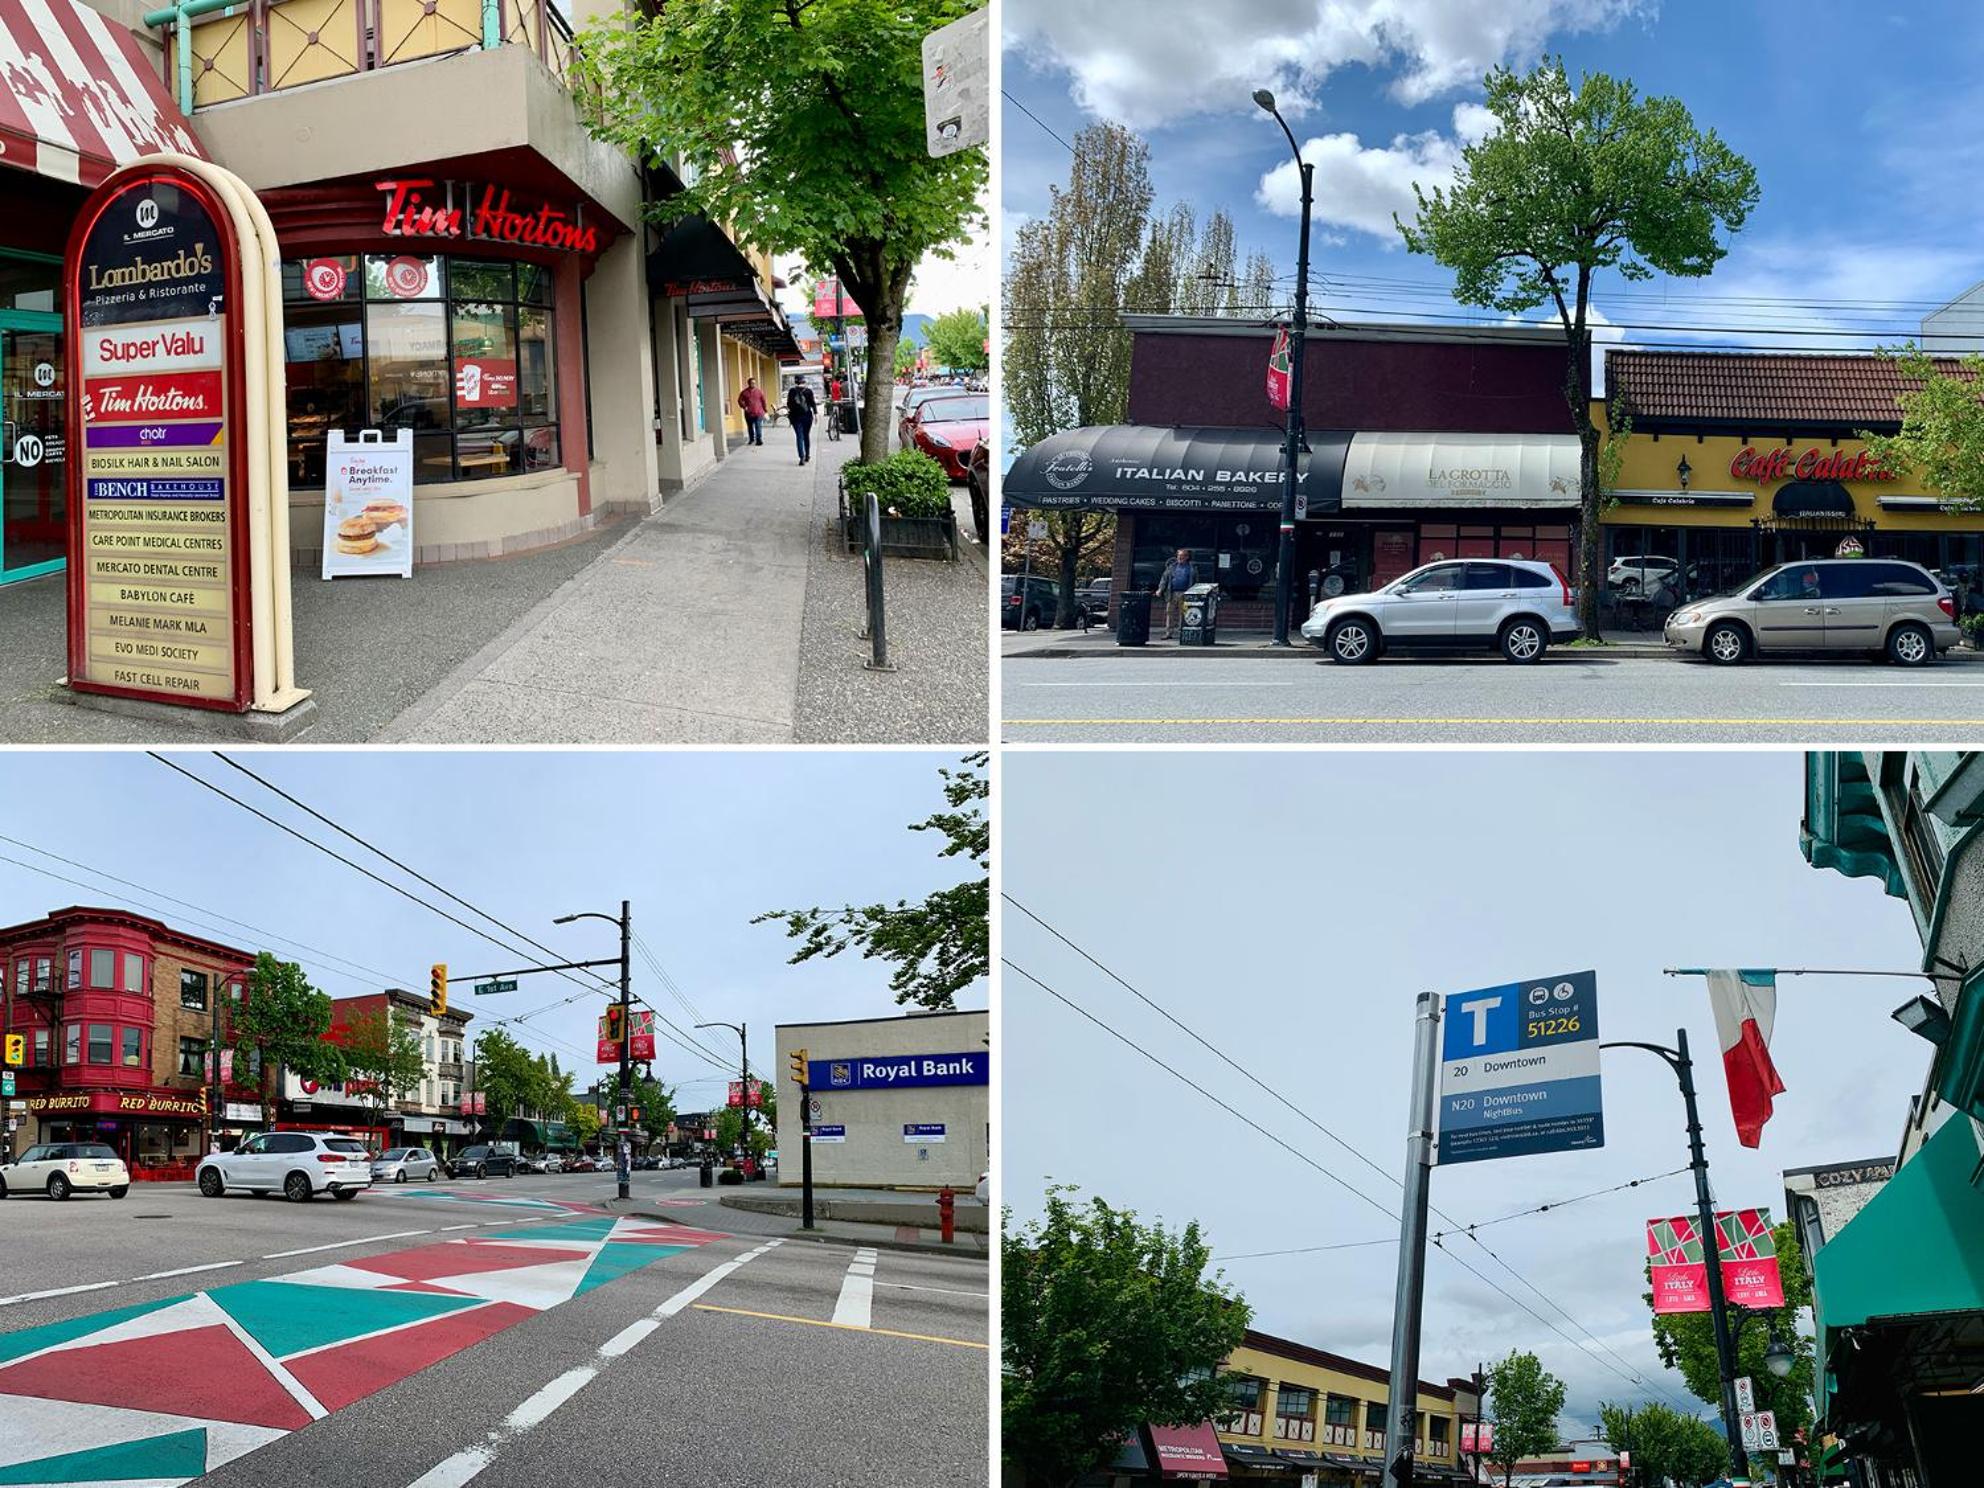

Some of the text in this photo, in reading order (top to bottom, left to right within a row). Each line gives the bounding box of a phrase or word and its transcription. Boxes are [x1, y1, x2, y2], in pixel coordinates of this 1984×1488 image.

[375, 179, 597, 251] Tim Hortons
[133, 226, 174, 239] MERCATO
[89, 243, 213, 290] Lombardo's
[95, 283, 206, 306] Pizzeria & Ristorante
[99, 331, 205, 363] Super Valu
[99, 384, 205, 413] Tim Hortons
[140, 427, 167, 440] chatr
[20, 440, 40, 461] NO
[91, 455, 219, 469] BIOSILK HAIR & NAIL SALON
[1730, 447, 1792, 487] Café
[349, 465, 398, 476] Breakfast
[1115, 467, 1310, 484] ITALIAN BAKERY
[1448, 468, 1511, 481] GROTTA
[348, 474, 393, 486] Anytime.
[98, 482, 147, 497] BENCH
[150, 483, 219, 491] BAKEHOUSE
[1090, 497, 1128, 505] WEDDING
[89, 509, 226, 522] METROPOLITAN INSURANCE BROKERS
[92, 535, 223, 551] CARE POINT MEDICAL CENTRES
[96, 561, 218, 578] MERCATO DENTAL CENTRE
[120, 588, 167, 603] BABYLON
[109, 615, 207, 634] MELANIE MARK MLA
[115, 642, 199, 661] EVO MEDI SOCIETY
[114, 670, 200, 691] FAST CELL REPAIR
[1528, 1009, 1546, 1020] Bus
[1548, 1006, 1571, 1017] Stop
[1460, 996, 1503, 1047] T
[1527, 1016, 1581, 1039] 51226
[863, 1058, 974, 1082] Royal Bank
[1453, 1054, 1547, 1078] 20 Downtown
[30, 1096, 90, 1109] RED BURRITO
[120, 1097, 146, 1110] RED
[1451, 1089, 1548, 1112] N20 Downtown
[1483, 1106, 1524, 1120] NightBus
[1664, 1279, 1694, 1290] ITALY
[1734, 1275, 1765, 1286] ITALY
